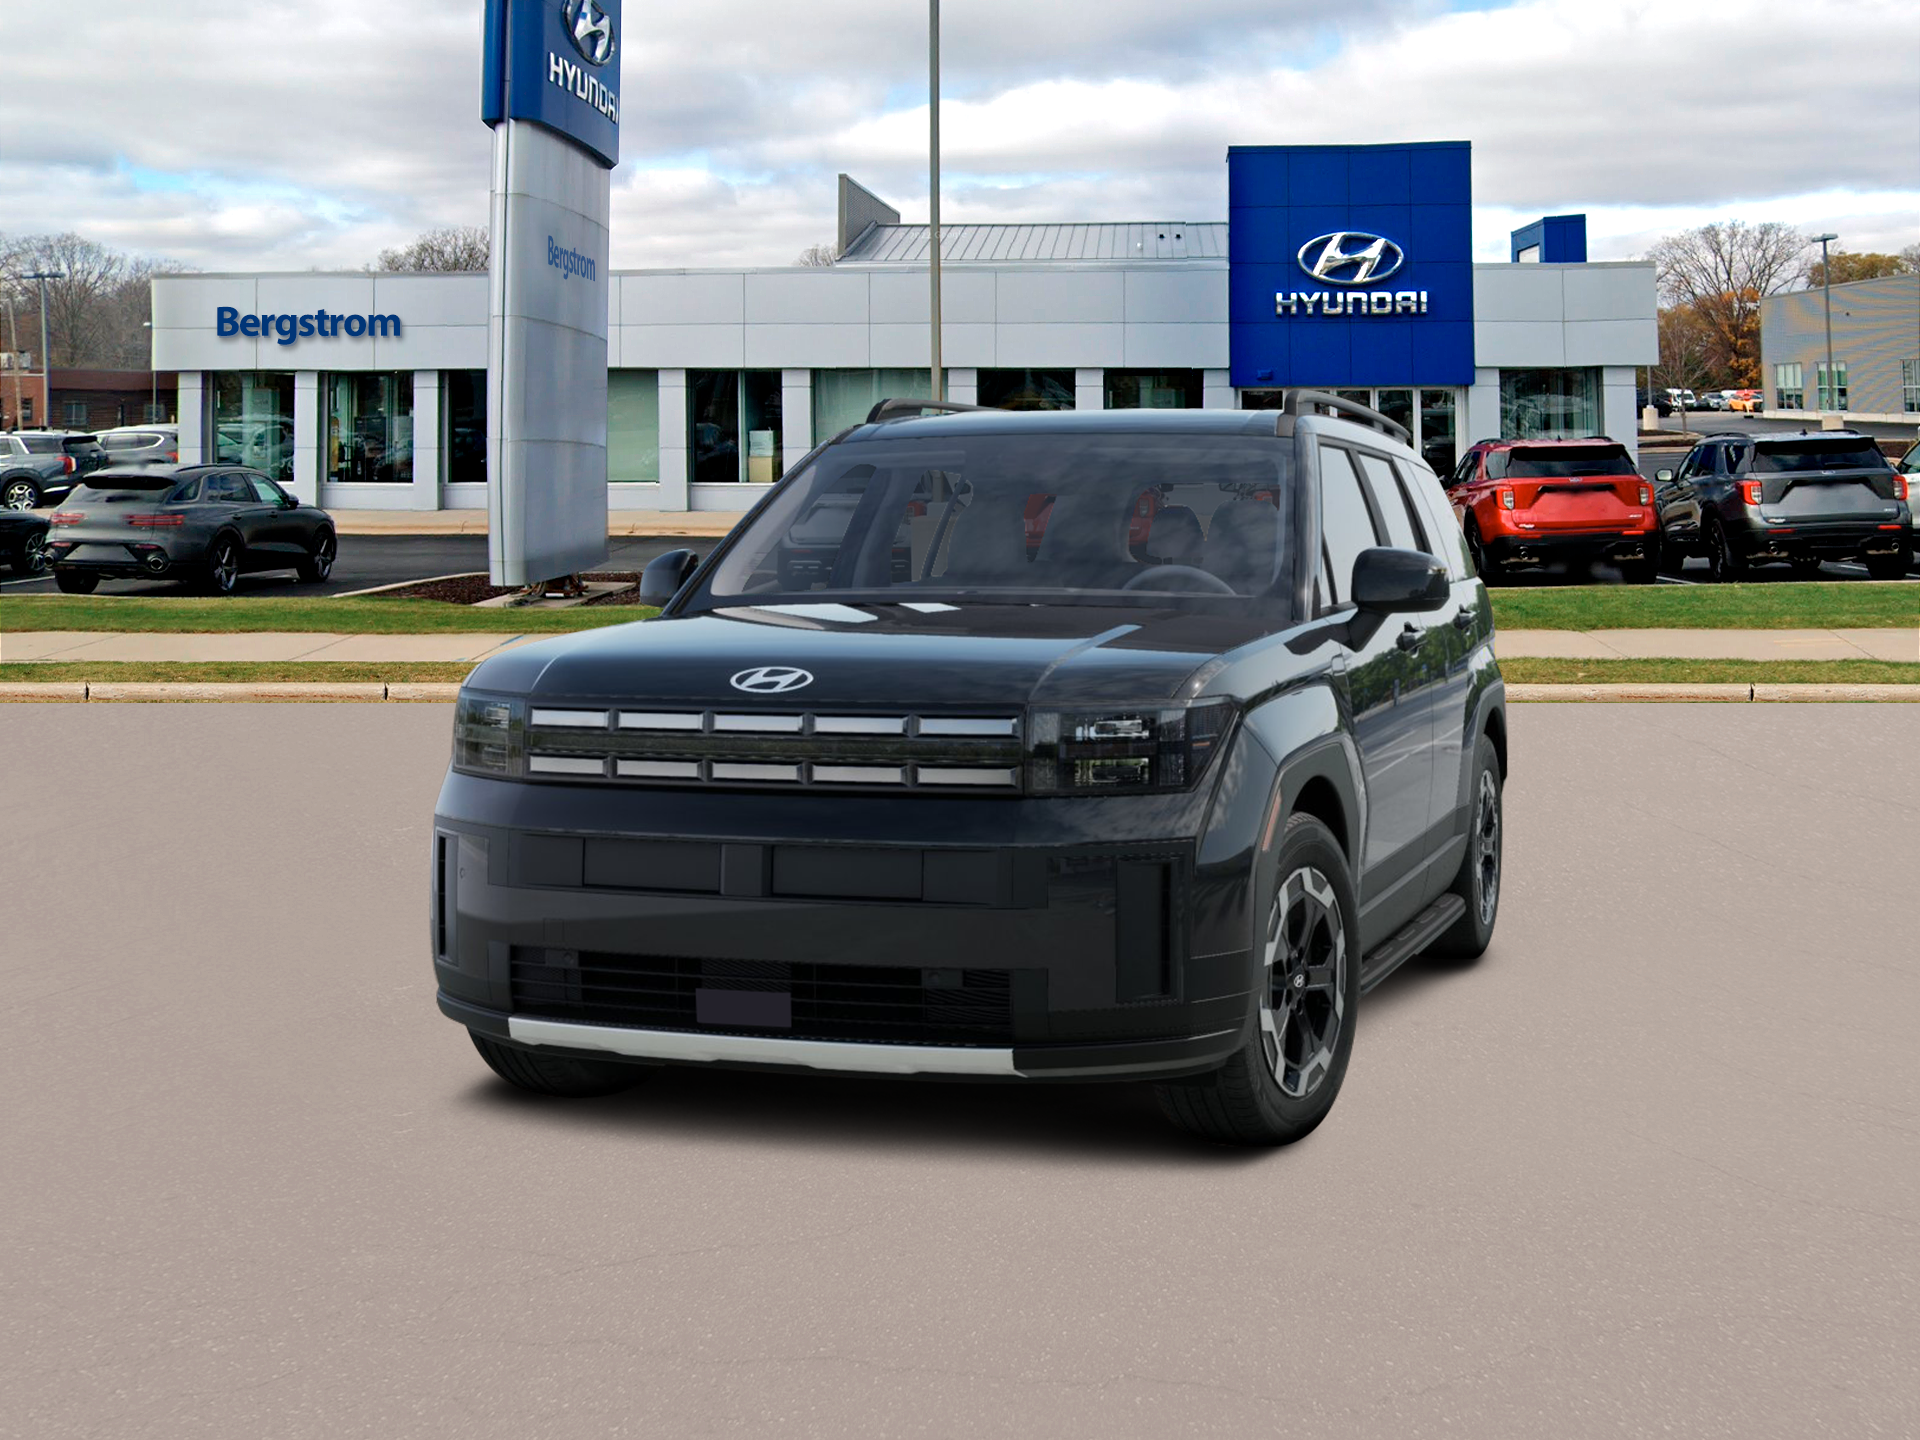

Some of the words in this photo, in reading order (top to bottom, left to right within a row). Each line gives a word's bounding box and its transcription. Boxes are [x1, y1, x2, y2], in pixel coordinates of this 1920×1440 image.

[549, 51, 619, 124] HYUNDAI
[547, 235, 595, 281] Bergstrom
[1276, 290, 1428, 314] HYUNDAI
[216, 306, 402, 346] Bergstrom
